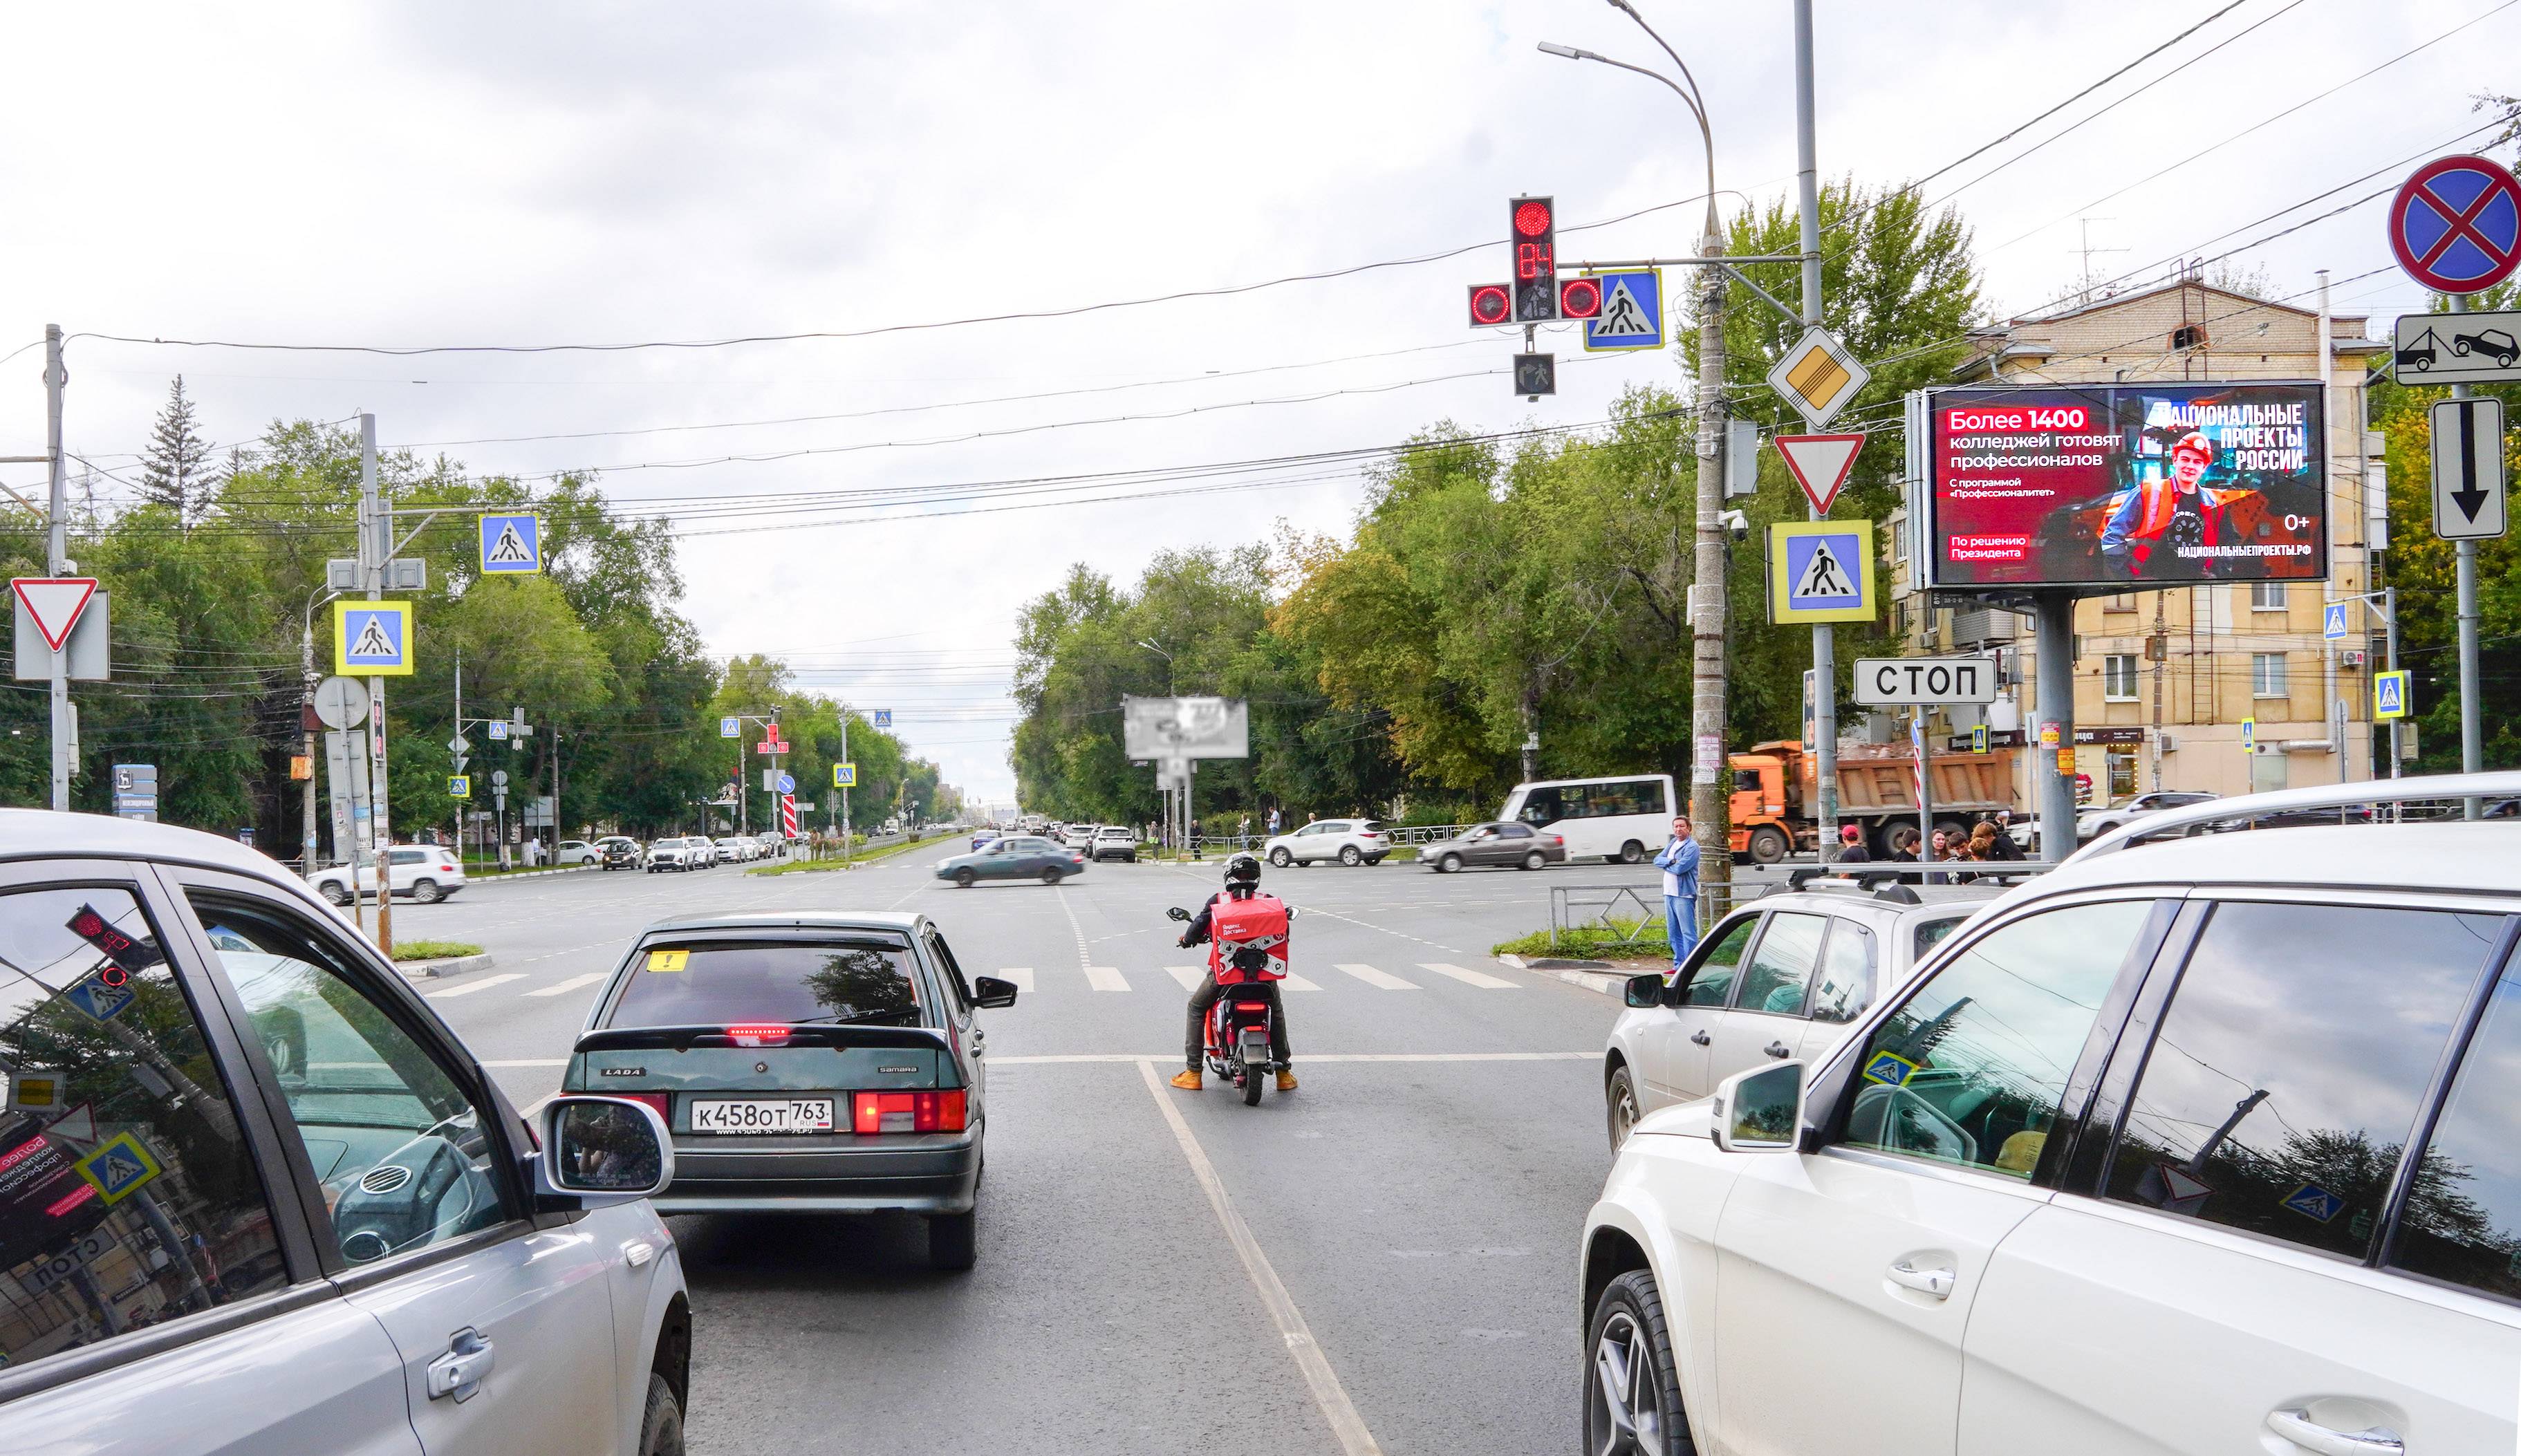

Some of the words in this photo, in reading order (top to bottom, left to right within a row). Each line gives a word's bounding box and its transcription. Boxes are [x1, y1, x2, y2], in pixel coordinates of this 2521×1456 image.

[1518, 243, 1554, 279] 84
[1951, 411, 2022, 429] Более
[2028, 409, 2084, 429] 1400
[1950, 433, 2050, 450] колледжей
[2056, 435, 2122, 447] готовят
[2220, 427, 2303, 449] ПРОЕКТЫ
[1951, 453, 2103, 471] профессионалов
[2235, 449, 2303, 470] РОССИИ
[1949, 479, 1957, 487] С
[1959, 478, 2021, 488] программой
[1950, 489, 2055, 498] «Профессионалитет»
[2284, 514, 2310, 530] 0+
[1952, 537, 1968, 546] По
[1971, 537, 2026, 548] решению
[1952, 549, 2021, 560] Президента
[2178, 545, 2311, 558] НАЦИОНАЛЬНЫЕПРОЕКТЫ.РФ
[1877, 666, 1975, 695] СТОП
[792, 1103, 826, 1120] 763
